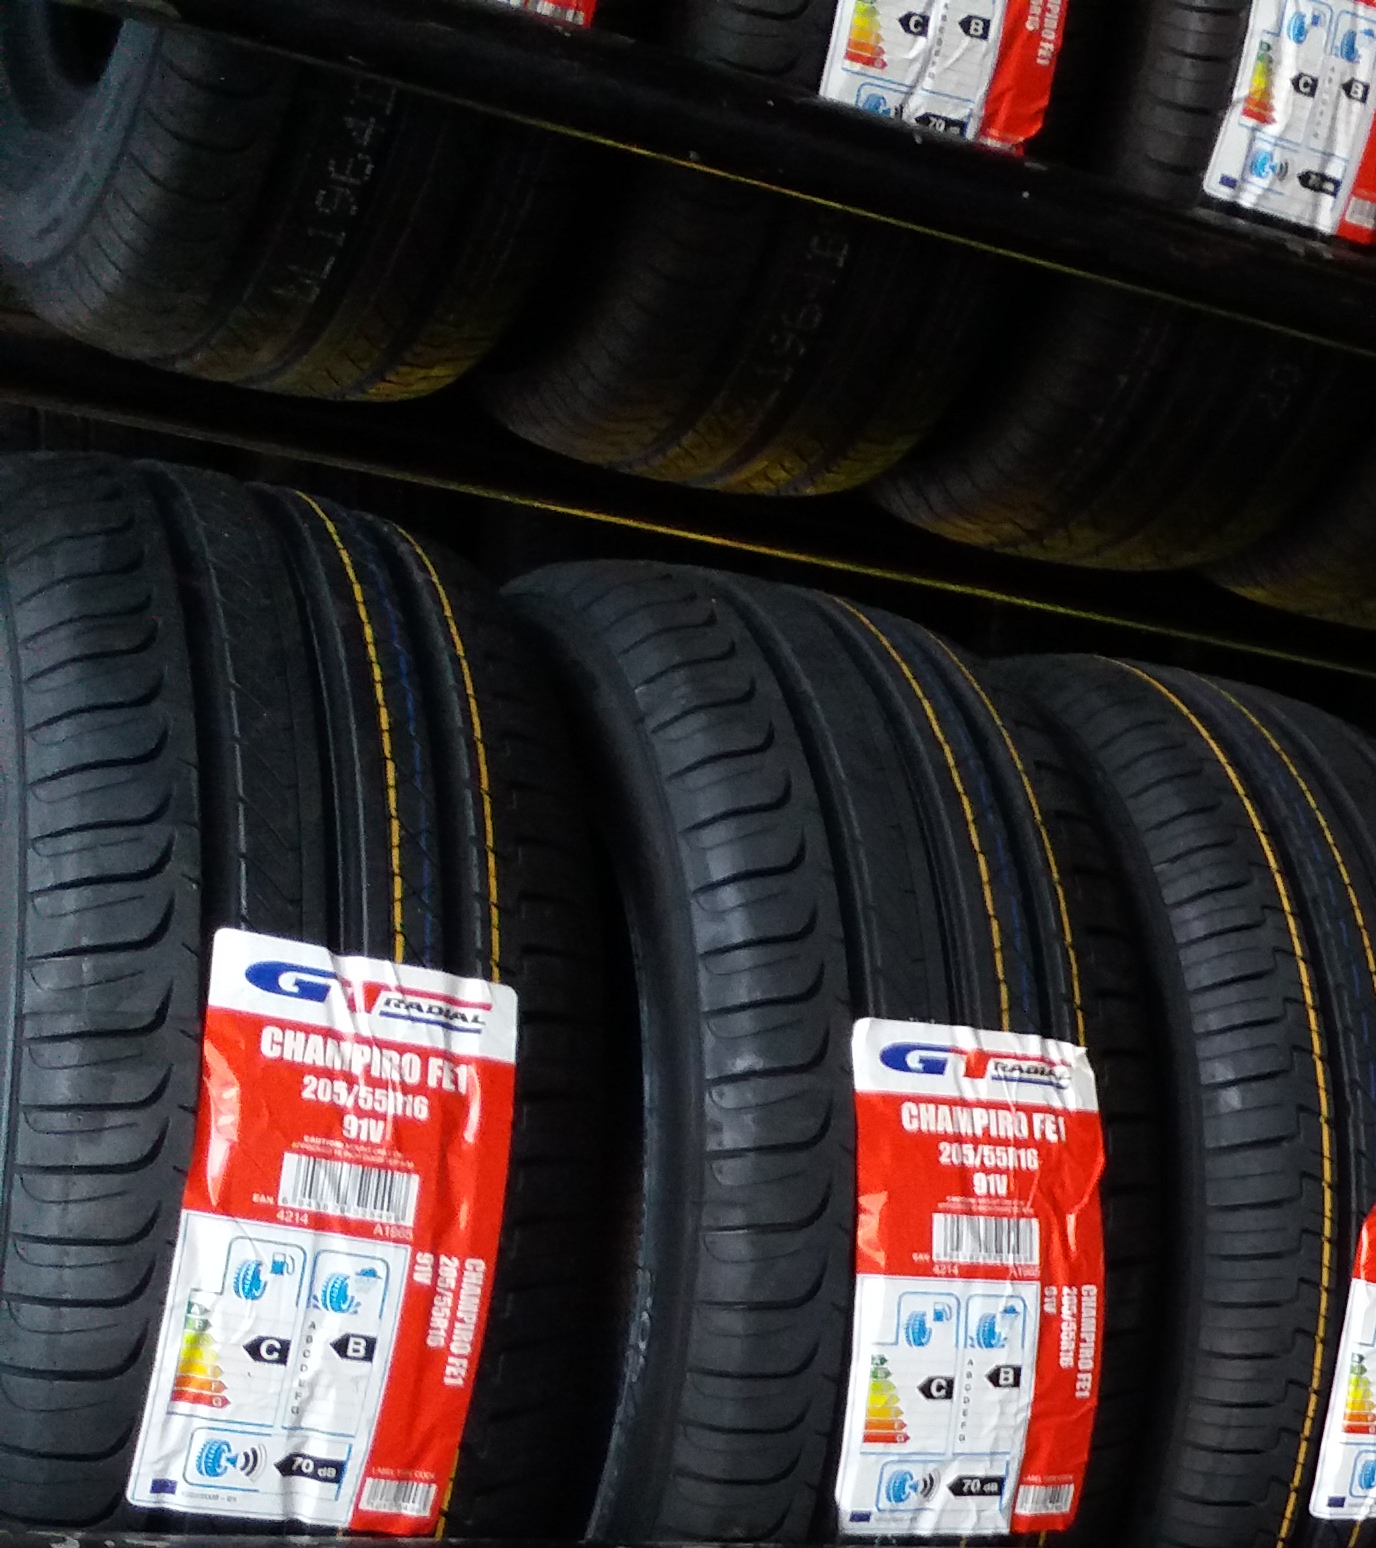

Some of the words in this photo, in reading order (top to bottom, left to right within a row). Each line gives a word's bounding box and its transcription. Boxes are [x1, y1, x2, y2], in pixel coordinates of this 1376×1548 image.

[909, 15, 923, 32] C
[969, 18, 985, 35] B
[1299, 76, 1312, 92] C
[1350, 82, 1364, 98] B
[928, 118, 946, 132] 70
[384, 996, 487, 1026] RADIAL
[260, 1025, 421, 1085] CHAMPIRO
[427, 1056, 469, 1094] FE1
[300, 1075, 430, 1122] 205/55R16
[342, 1114, 386, 1144] 91V
[901, 1101, 1029, 1139] CHAMPIRO
[1033, 1112, 1067, 1143] FE1
[973, 1172, 1008, 1197] 91V
[275, 1209, 310, 1226] 4214
[448, 1256, 486, 1357] CHAMPIRO
[1077, 1283, 1098, 1370] CHAMPIRO
[259, 1343, 281, 1361] C
[346, 1337, 366, 1359] B
[443, 1356, 469, 1387] FE1
[999, 1367, 1014, 1386] B
[930, 1378, 947, 1397] C
[290, 1456, 314, 1474] 70
[962, 1479, 981, 1491] 70
